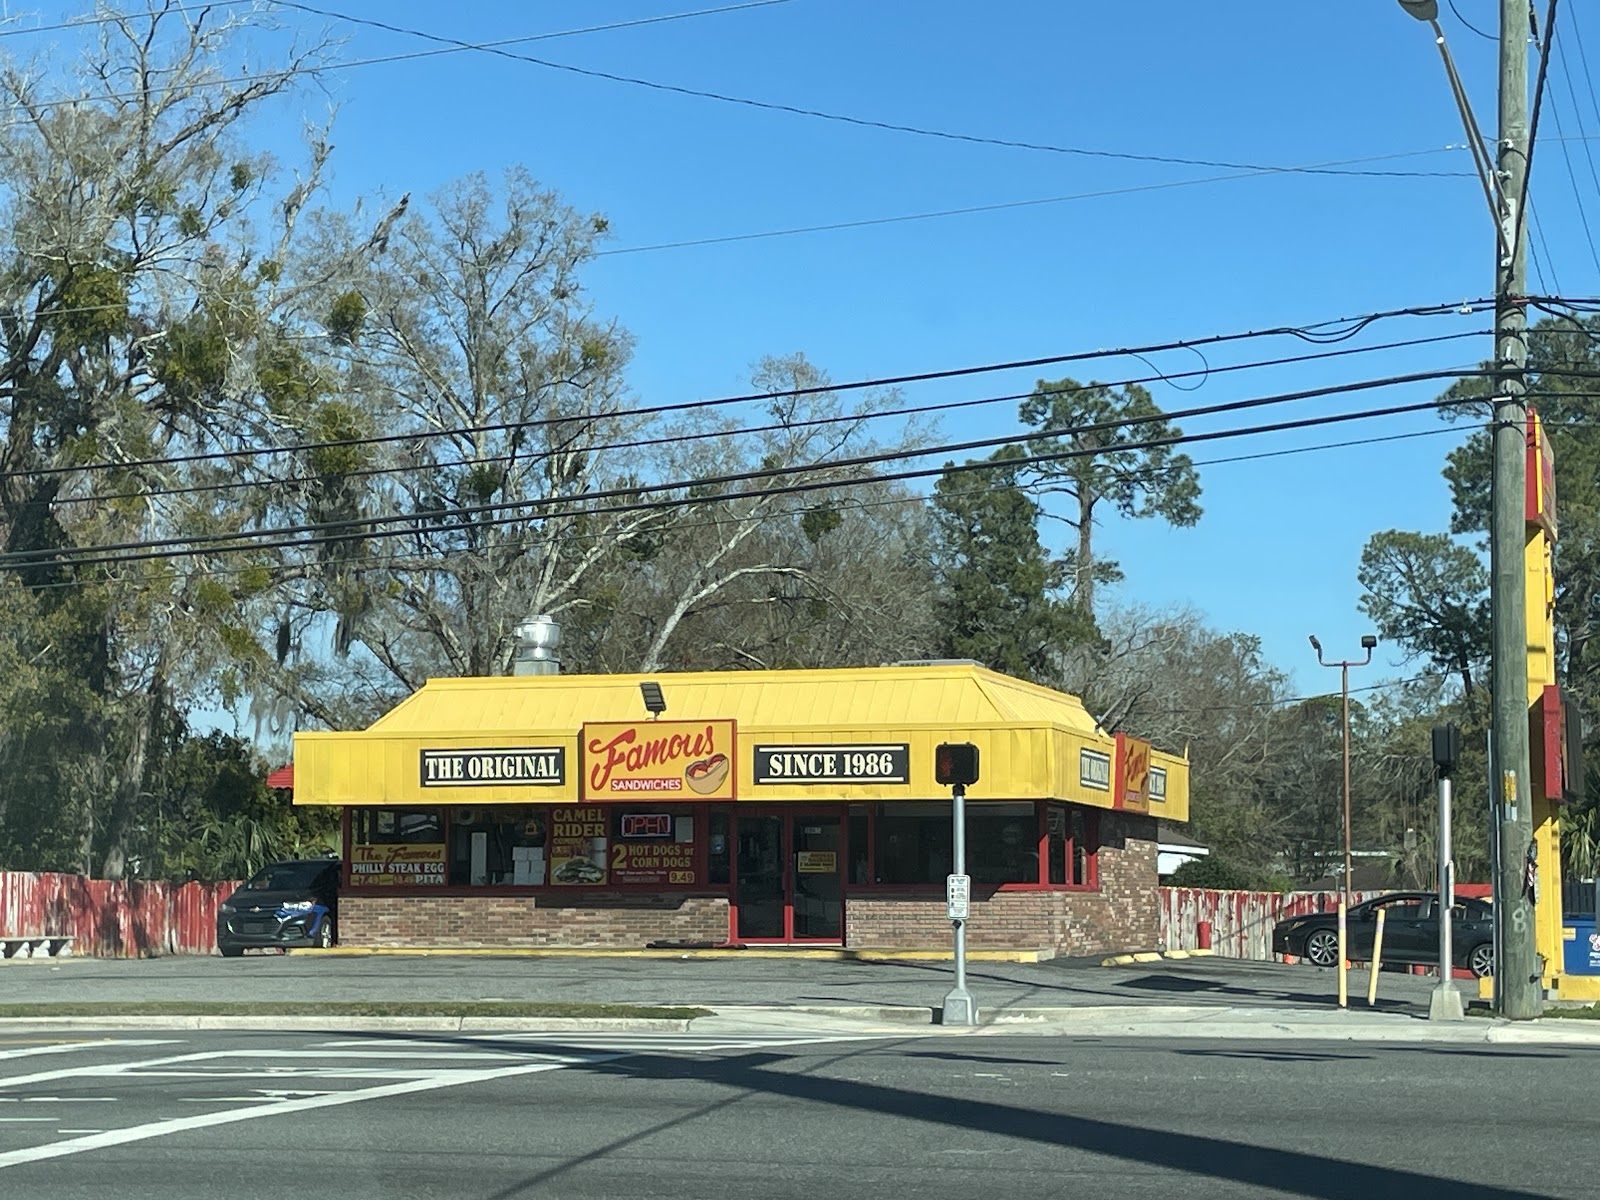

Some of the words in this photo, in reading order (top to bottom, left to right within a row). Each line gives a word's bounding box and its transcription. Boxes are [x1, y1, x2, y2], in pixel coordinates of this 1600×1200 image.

[589, 725, 714, 791] Famous
[769, 753, 837, 776] SINCE
[843, 753, 893, 776] 1986
[425, 757, 464, 779] THE
[468, 755, 560, 779] ORIGINAL
[611, 778, 682, 791] SANDWICHES
[553, 809, 606, 822] CAMEL
[553, 823, 606, 837] RIDER
[623, 816, 671, 834] OPEN
[355, 846, 383, 861] The
[385, 846, 442, 865] Famous
[612, 844, 628, 869] 2
[629, 845, 650, 856] HOT
[653, 844, 681, 856] DOGS
[352, 863, 385, 874] PHILLY
[388, 863, 422, 873] STEAK
[424, 863, 445, 873] EGG
[632, 857, 660, 868] CORN
[663, 856, 692, 868] DOGS
[415, 874, 443, 884] PITA
[670, 872, 694, 883] 9.49
